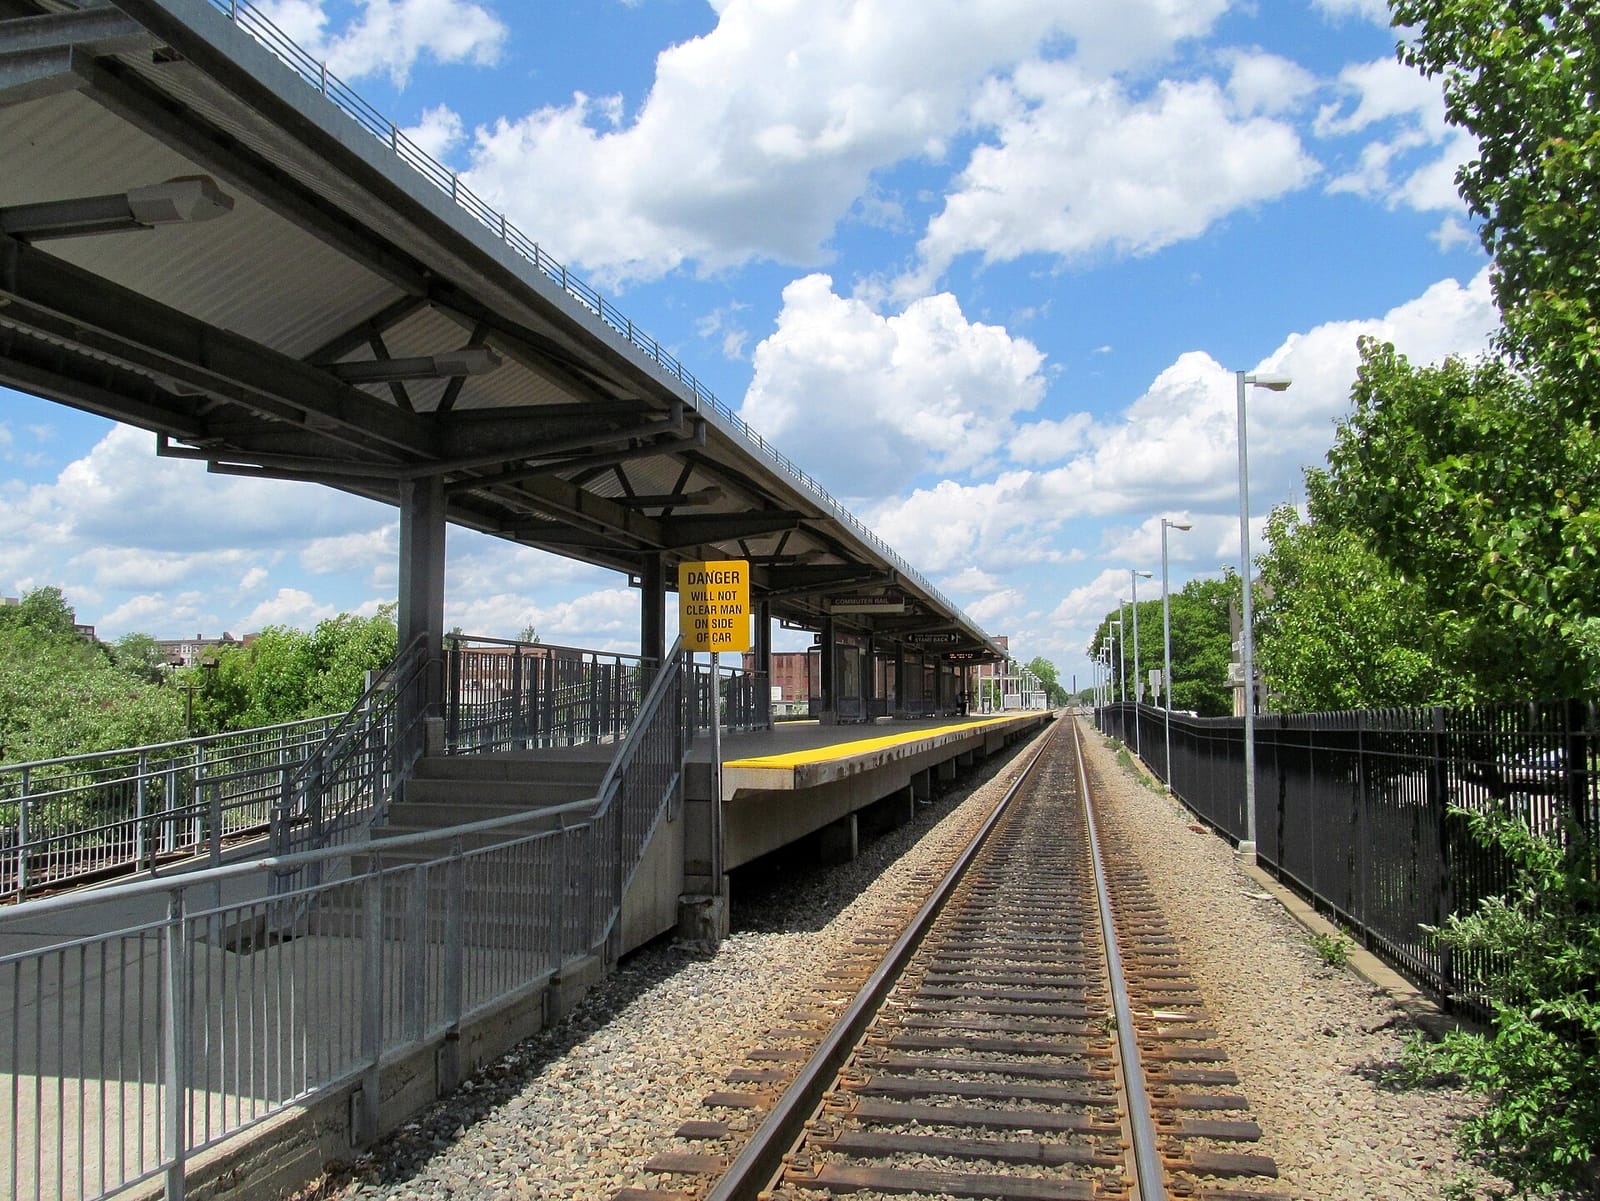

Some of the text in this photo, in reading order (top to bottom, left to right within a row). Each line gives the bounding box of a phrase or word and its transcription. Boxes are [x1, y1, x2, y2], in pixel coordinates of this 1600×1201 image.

[687, 571, 740, 585] DANGER
[691, 591, 737, 601] WILL NOT
[686, 605, 742, 615] CLEAR MAN
[695, 618, 734, 629] ON SIDE
[696, 632, 732, 643] OF CAR
